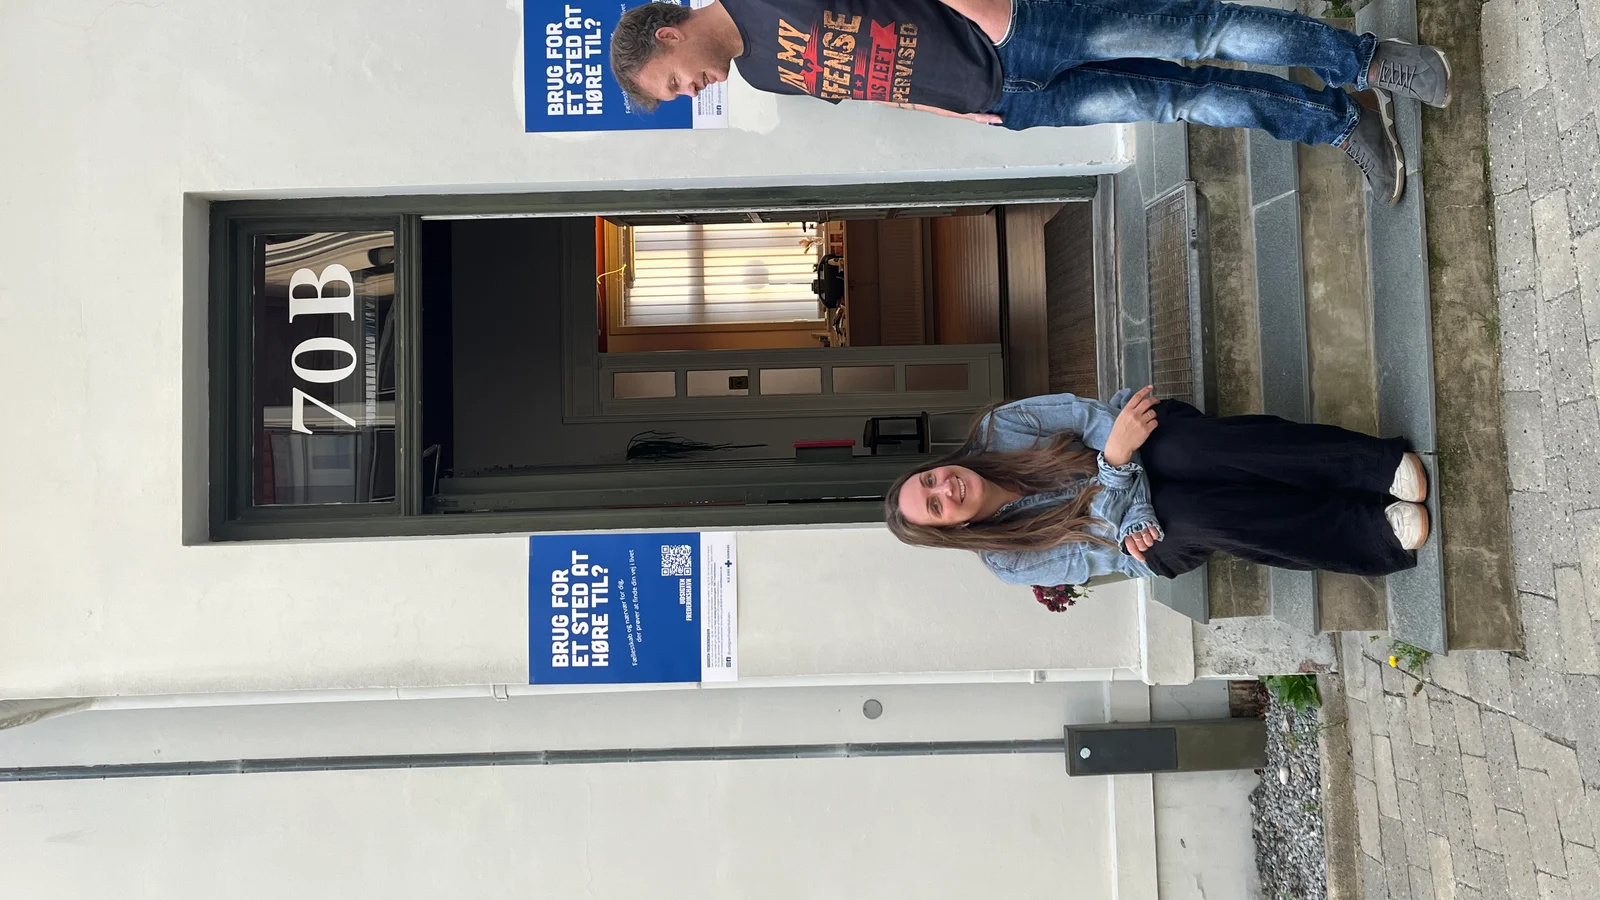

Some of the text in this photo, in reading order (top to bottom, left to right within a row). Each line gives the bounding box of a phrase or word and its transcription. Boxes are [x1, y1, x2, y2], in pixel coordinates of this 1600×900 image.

[546, 23, 564, 115] BRUG FOR
[565, 5, 583, 115] ET STED AT
[584, 18, 603, 114] HØRE TIL?
[777, 19, 811, 93] IN MY
[873, 44, 893, 82] LEFT
[892, 23, 918, 102] PERVISED
[552, 569, 568, 667] BRUG FOR
[571, 551, 589, 667] ET STED AT
[591, 565, 609, 667] HØRE TIL?
[621, 601, 631, 624] nærvær
[628, 634, 638, 666] Fællesskab
[632, 611, 642, 631] prøver
